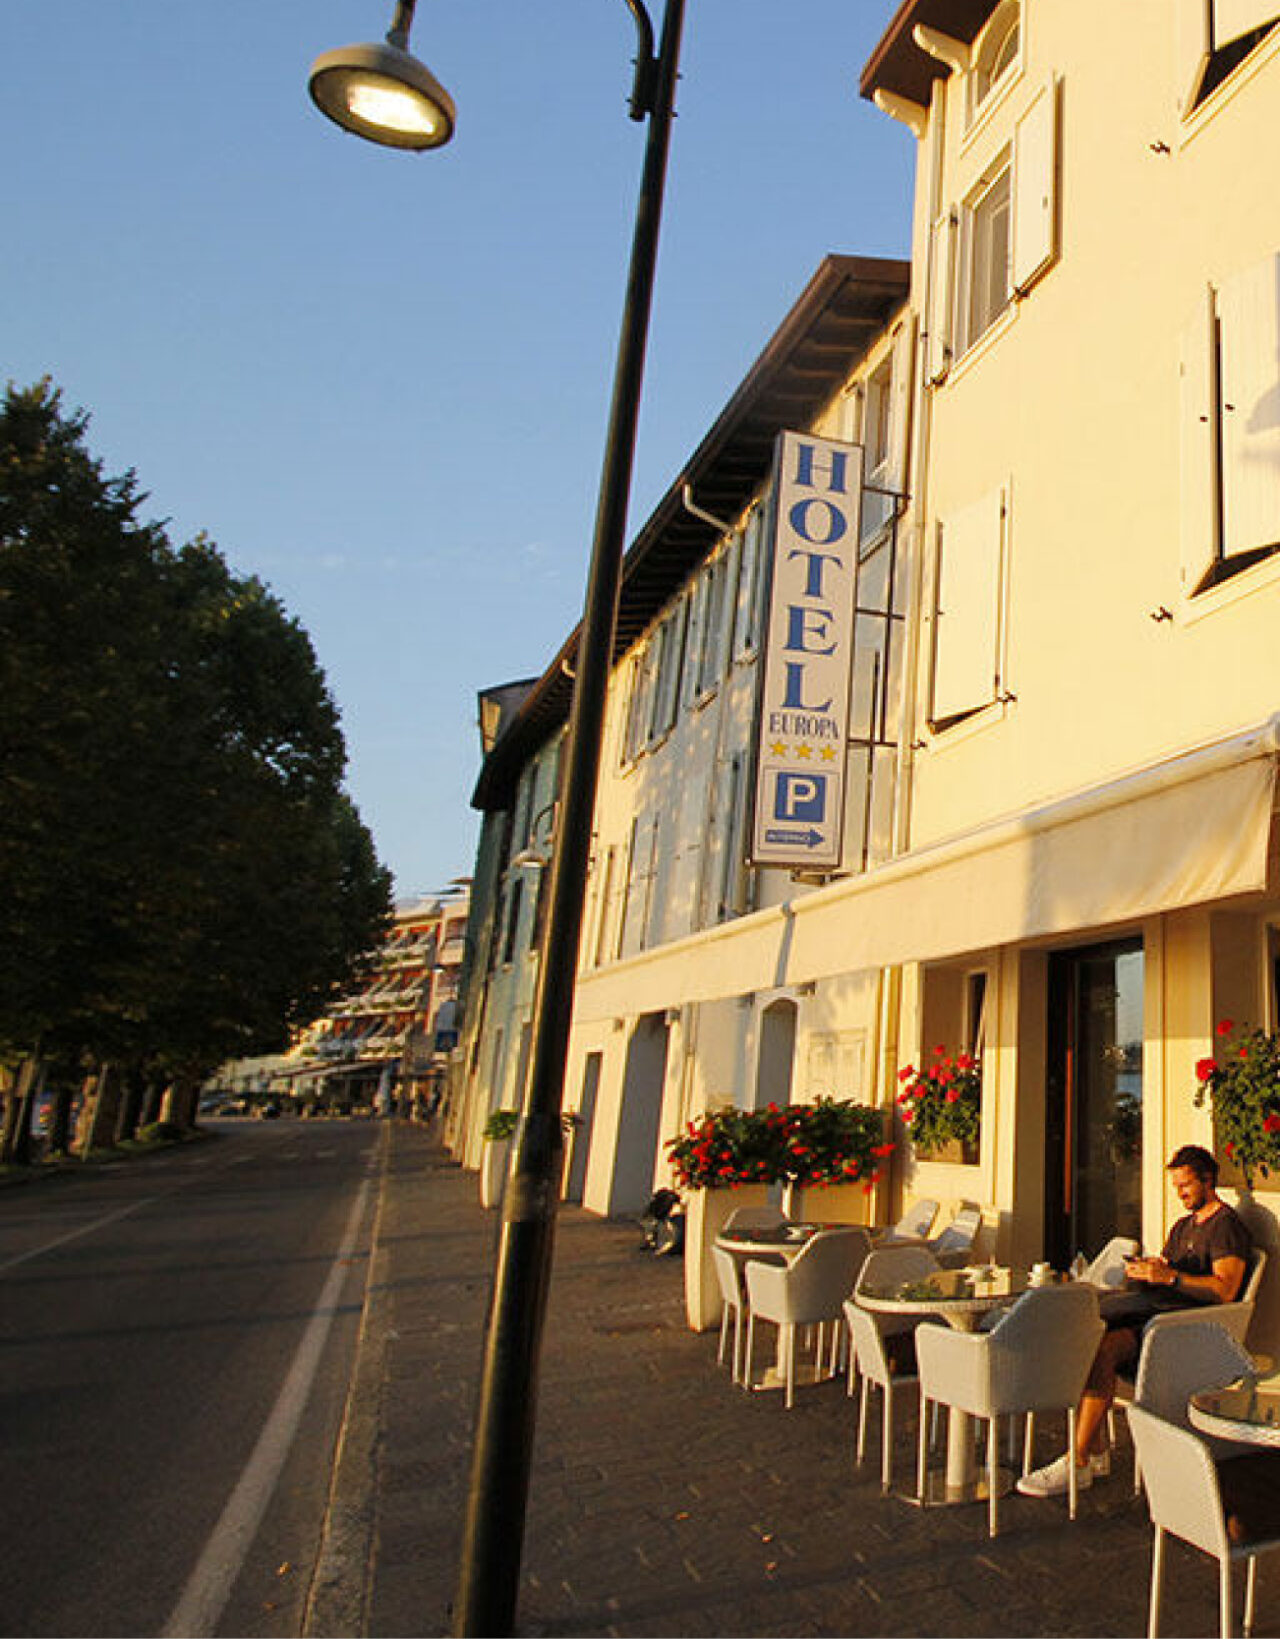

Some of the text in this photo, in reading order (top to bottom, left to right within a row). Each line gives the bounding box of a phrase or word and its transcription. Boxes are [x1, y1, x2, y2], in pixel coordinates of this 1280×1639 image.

[782, 442, 848, 714] HOTEL
[770, 713, 839, 740] EUROPA
[787, 777, 816, 817] P
